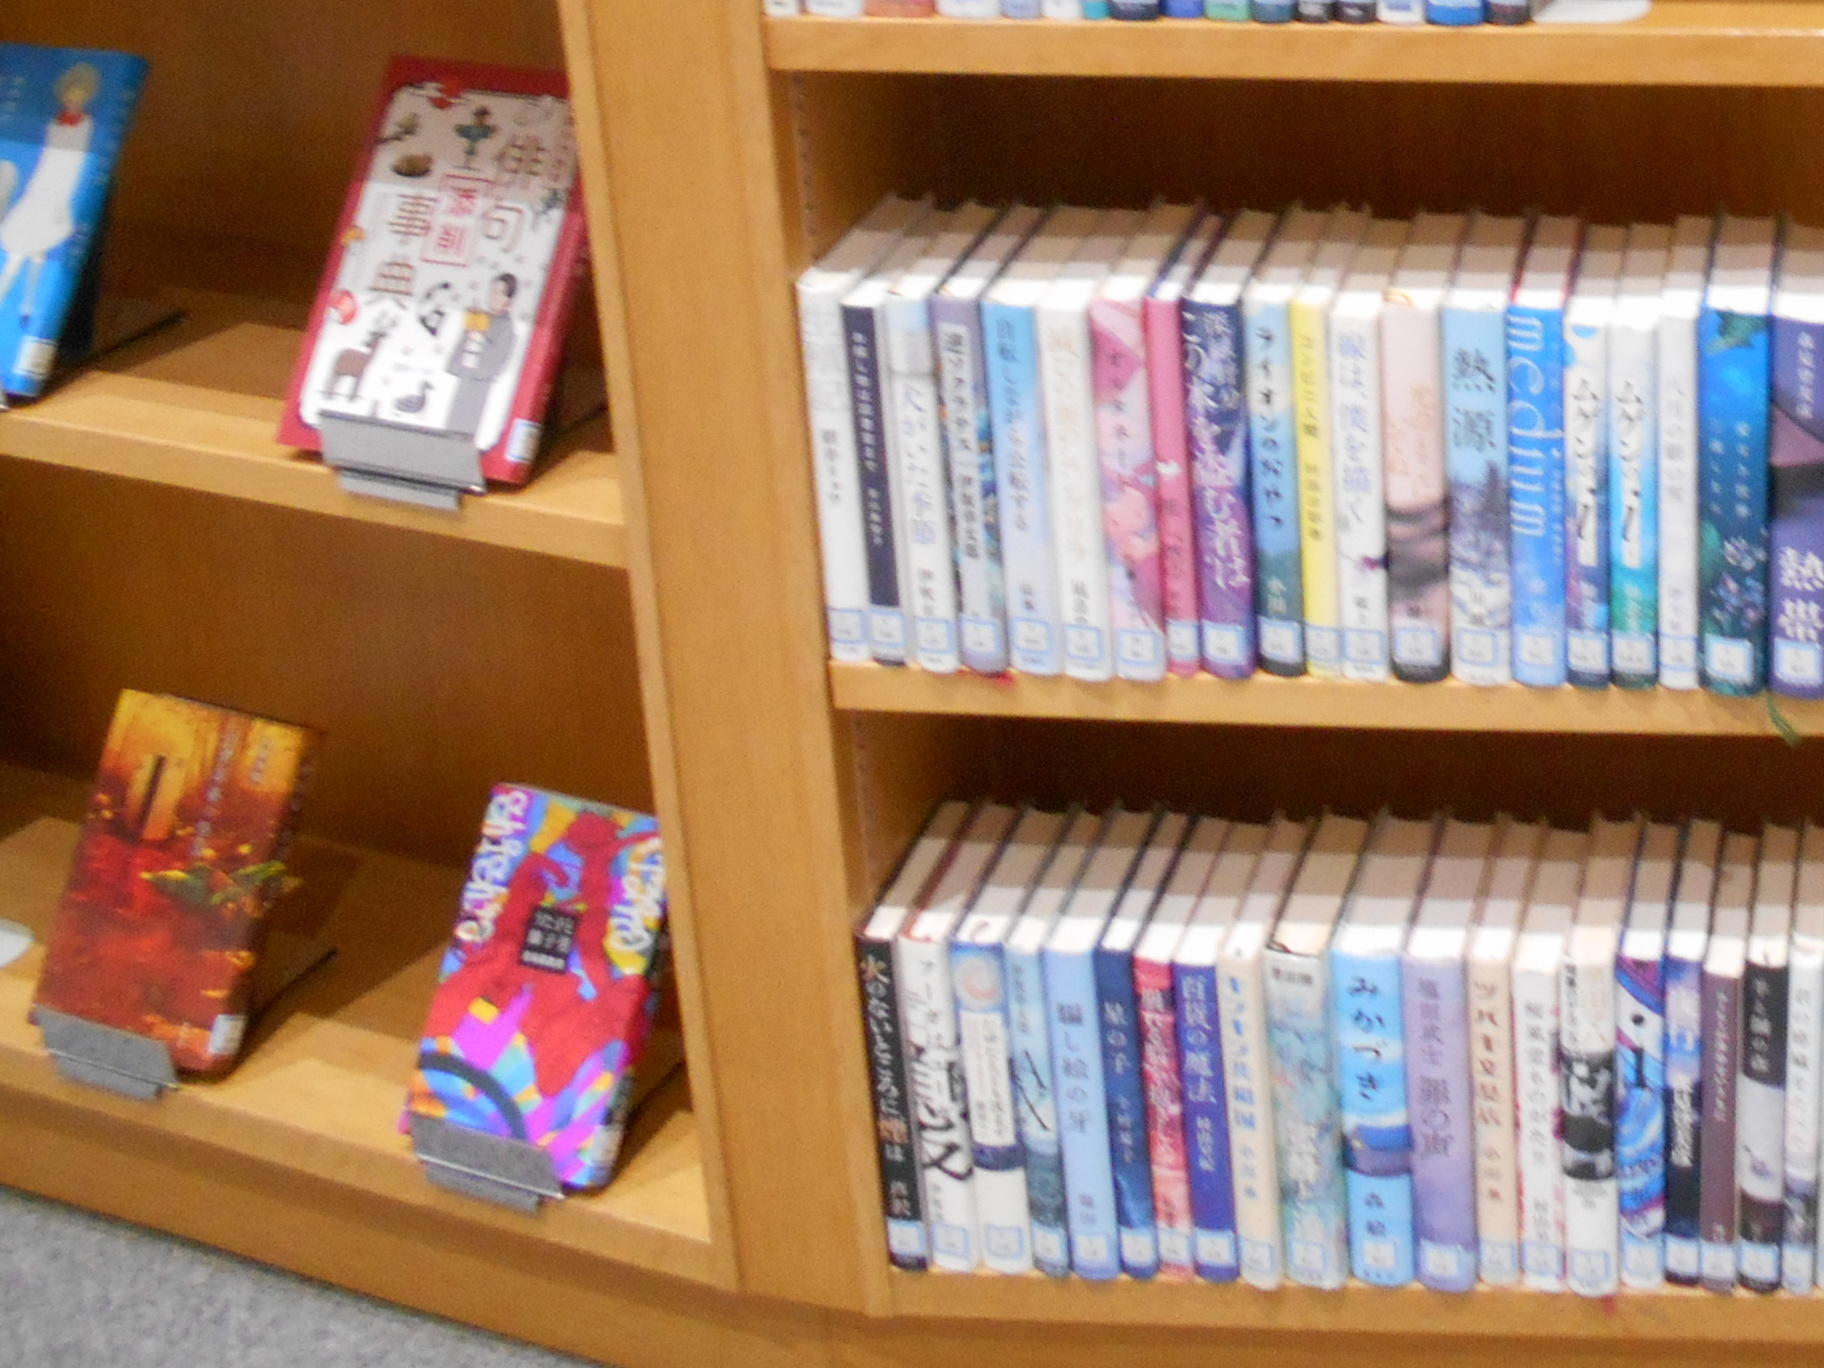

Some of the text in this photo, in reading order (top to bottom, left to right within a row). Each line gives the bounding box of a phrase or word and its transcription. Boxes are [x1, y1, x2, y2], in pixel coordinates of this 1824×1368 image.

[1452, 345, 1495, 454] 熱源
[1507, 315, 1564, 536] medium
[1347, 974, 1386, 1101] みかづき
